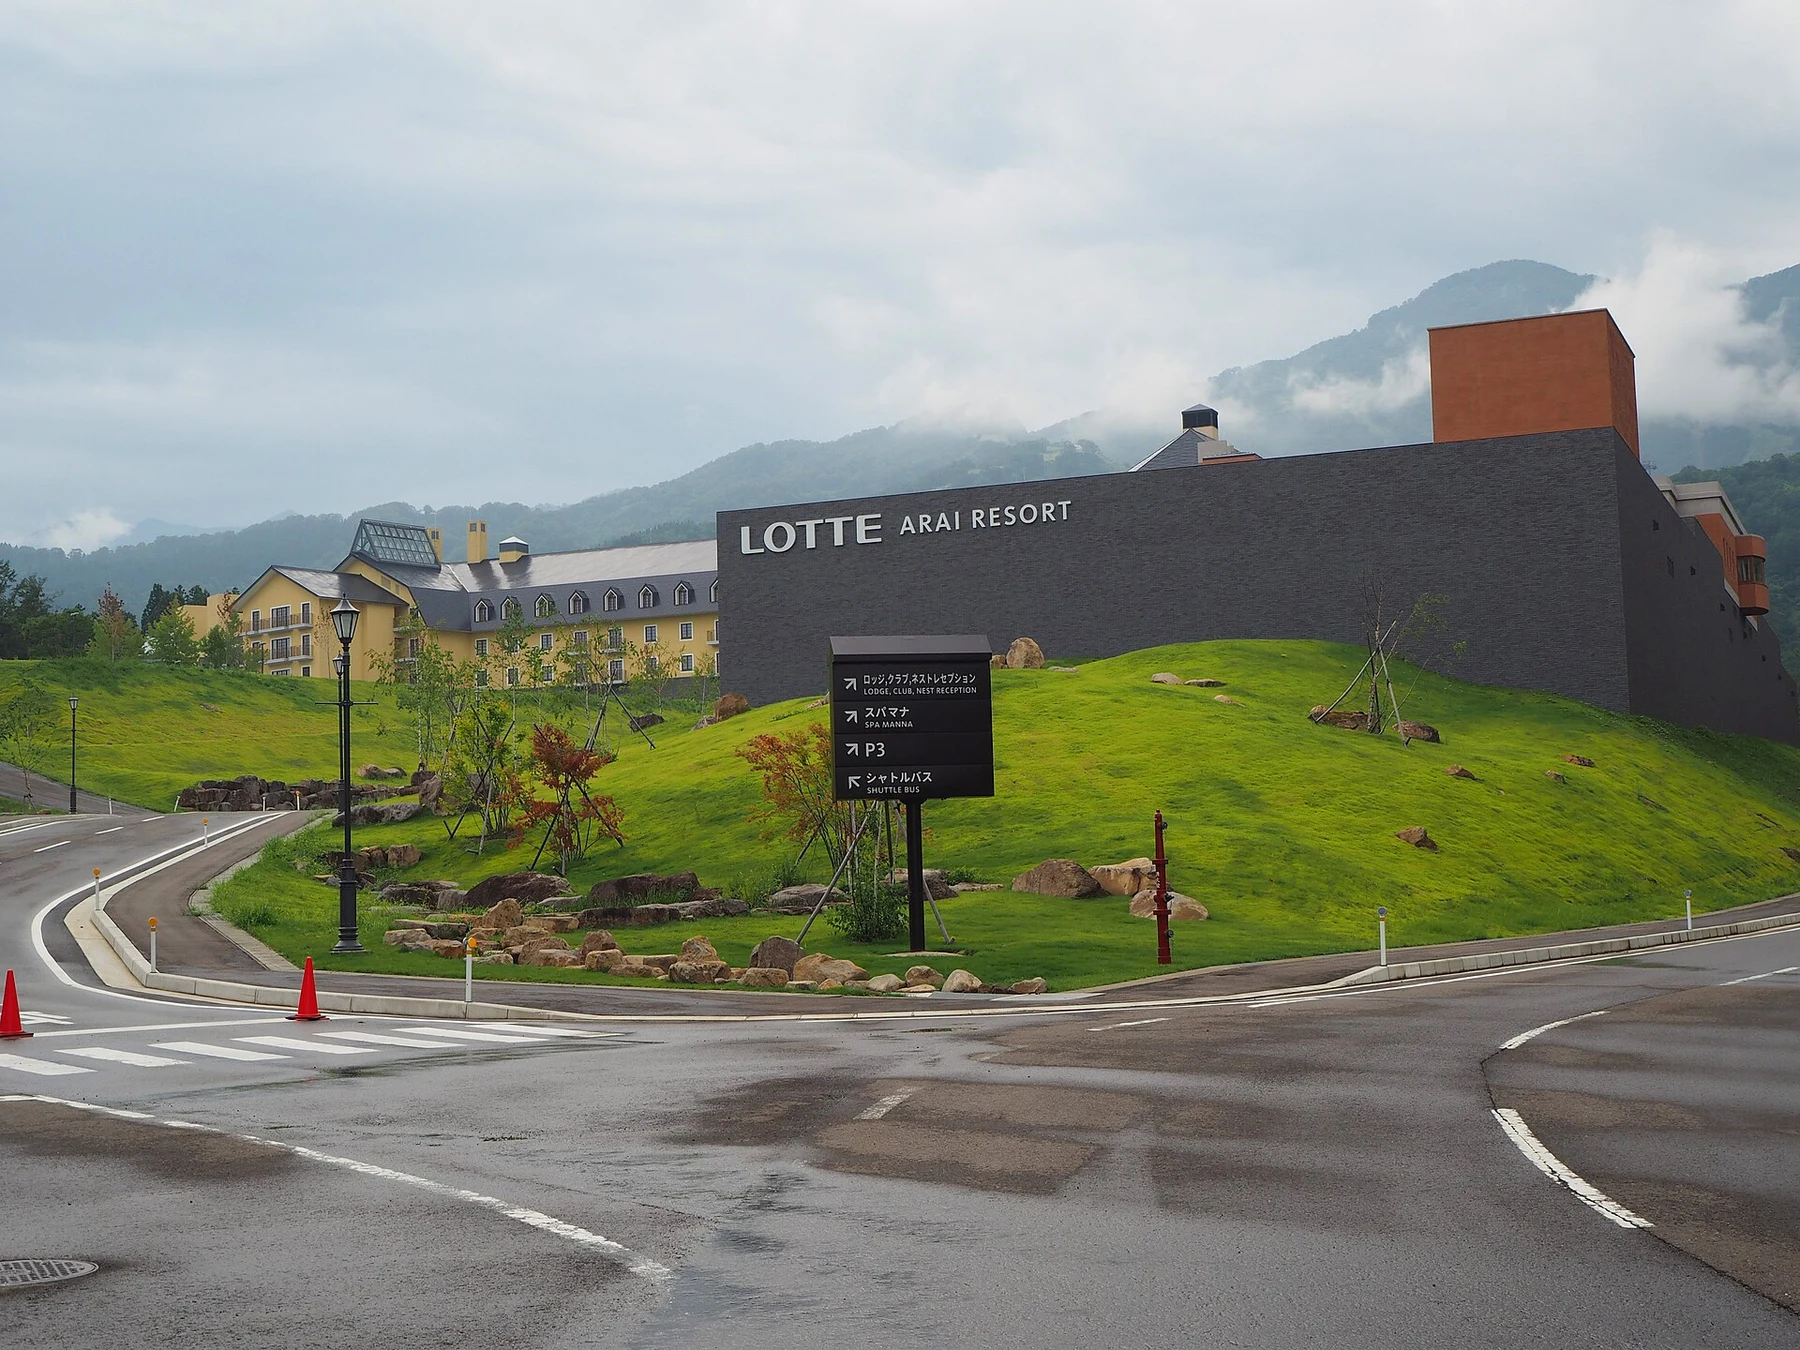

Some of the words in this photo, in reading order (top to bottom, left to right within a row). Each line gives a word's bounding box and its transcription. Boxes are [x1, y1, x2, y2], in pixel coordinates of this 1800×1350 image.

[740, 513, 883, 555] LOTTE
[900, 511, 960, 535] ARAI
[971, 500, 1072, 529] RESORT
[863, 687, 892, 696] LODGE,
[893, 687, 915, 696] CLUB,
[916, 687, 935, 695] NEST
[936, 686, 977, 695] RECEPTION
[864, 706, 910, 718] スパマナ
[864, 721, 880, 729] SPA
[882, 720, 913, 729] MANNA
[865, 742, 886, 758] P3
[866, 771, 933, 784] シャトルバス
[866, 786, 902, 794] SHUTTLE
[904, 785, 920, 794] BUS
